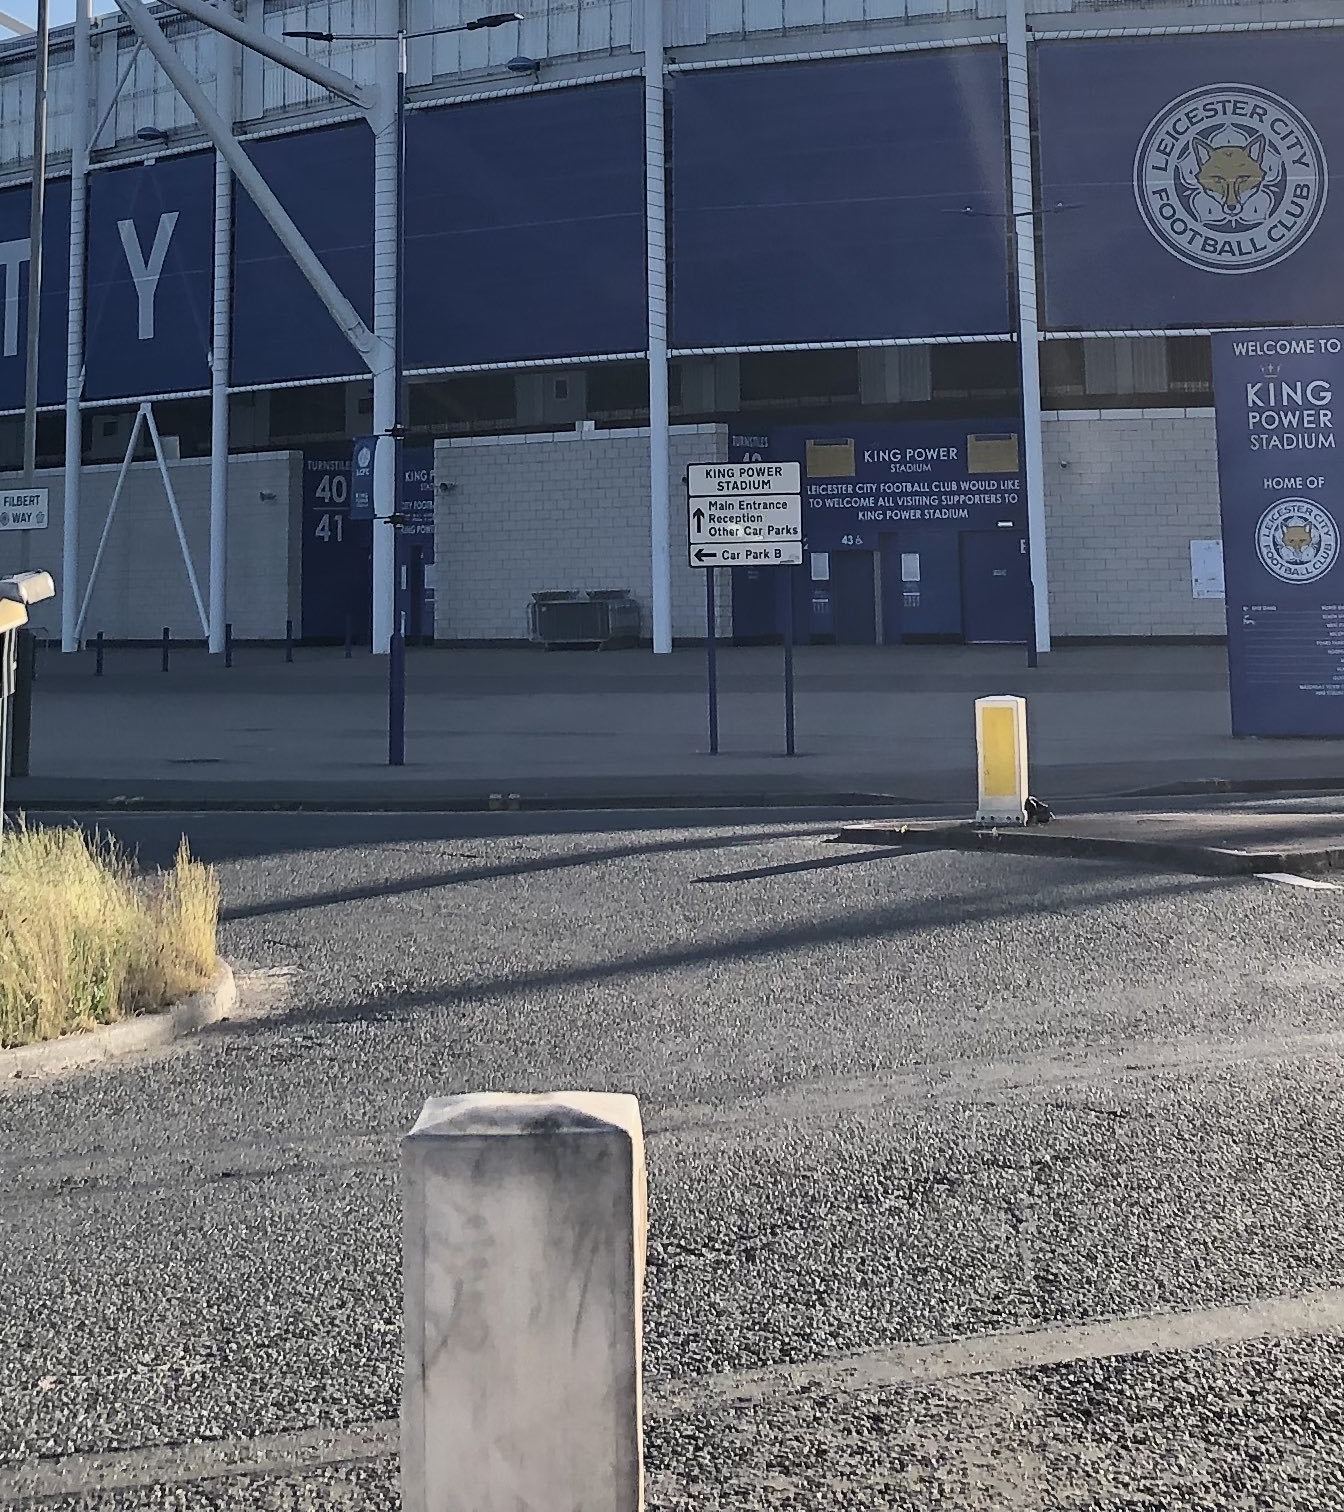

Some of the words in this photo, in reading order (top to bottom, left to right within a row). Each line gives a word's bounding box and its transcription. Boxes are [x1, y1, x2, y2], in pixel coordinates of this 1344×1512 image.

[1151, 99, 1268, 173] LEICESTER
[1269, 117, 1311, 170] CITY
[1151, 187, 1268, 257] FOOTBALL
[1266, 181, 1311, 244] CLUB
[1233, 340, 1315, 356] WELCOME
[1318, 338, 1341, 353] TO
[1246, 380, 1332, 407] KING
[1248, 409, 1333, 430] POWER
[1250, 432, 1336, 450] STADIUM
[864, 449, 902, 463] KING
[906, 447, 958, 461] POWER
[308, 460, 352, 471] TURNSTILE
[890, 463, 932, 473] STADIUM
[405, 469, 428, 482] KING
[705, 468, 735, 479] KING
[739, 466, 783, 478] POWER
[315, 474, 348, 503] 40
[716, 479, 771, 491] STADIUM
[807, 484, 853, 495] LEICESTER
[856, 483, 877, 494] CITY
[880, 482, 930, 493] FOOTBALL
[932, 481, 958, 492] CLUB
[960, 480, 998, 491] WOULD
[1000, 479, 1021, 490] LIKE
[1263, 477, 1303, 489] HOME
[1306, 476, 1325, 489] OF
[3, 494, 41, 507] FILBERT
[708, 500, 735, 511] Main
[738, 500, 788, 511] Entrance
[809, 498, 823, 508] TO
[825, 497, 875, 508] WELCOME
[877, 496, 895, 507] ALL
[897, 495, 939, 506] VISITING
[941, 494, 1002, 505] SUPPORTERS
[1004, 493, 1019, 504] TO
[12, 512, 32, 524] WAY
[708, 513, 763, 525] Reception
[858, 510, 884, 521] KING
[886, 510, 921, 520] POWER
[924, 509, 968, 519] STADIUM
[1262, 504, 1314, 538] LEICESTER
[1313, 513, 1333, 538] CITY
[315, 513, 343, 542] 41
[708, 525, 740, 537] Other
[743, 526, 764, 537] Car
[767, 524, 799, 536] Parks
[841, 535, 854, 545] 43
[721, 549, 741, 560] Car
[745, 547, 771, 560] Park
[774, 548, 782, 559] B
[1263, 544, 1314, 577] FOOTBALL
[1312, 543, 1333, 571] CLUB
